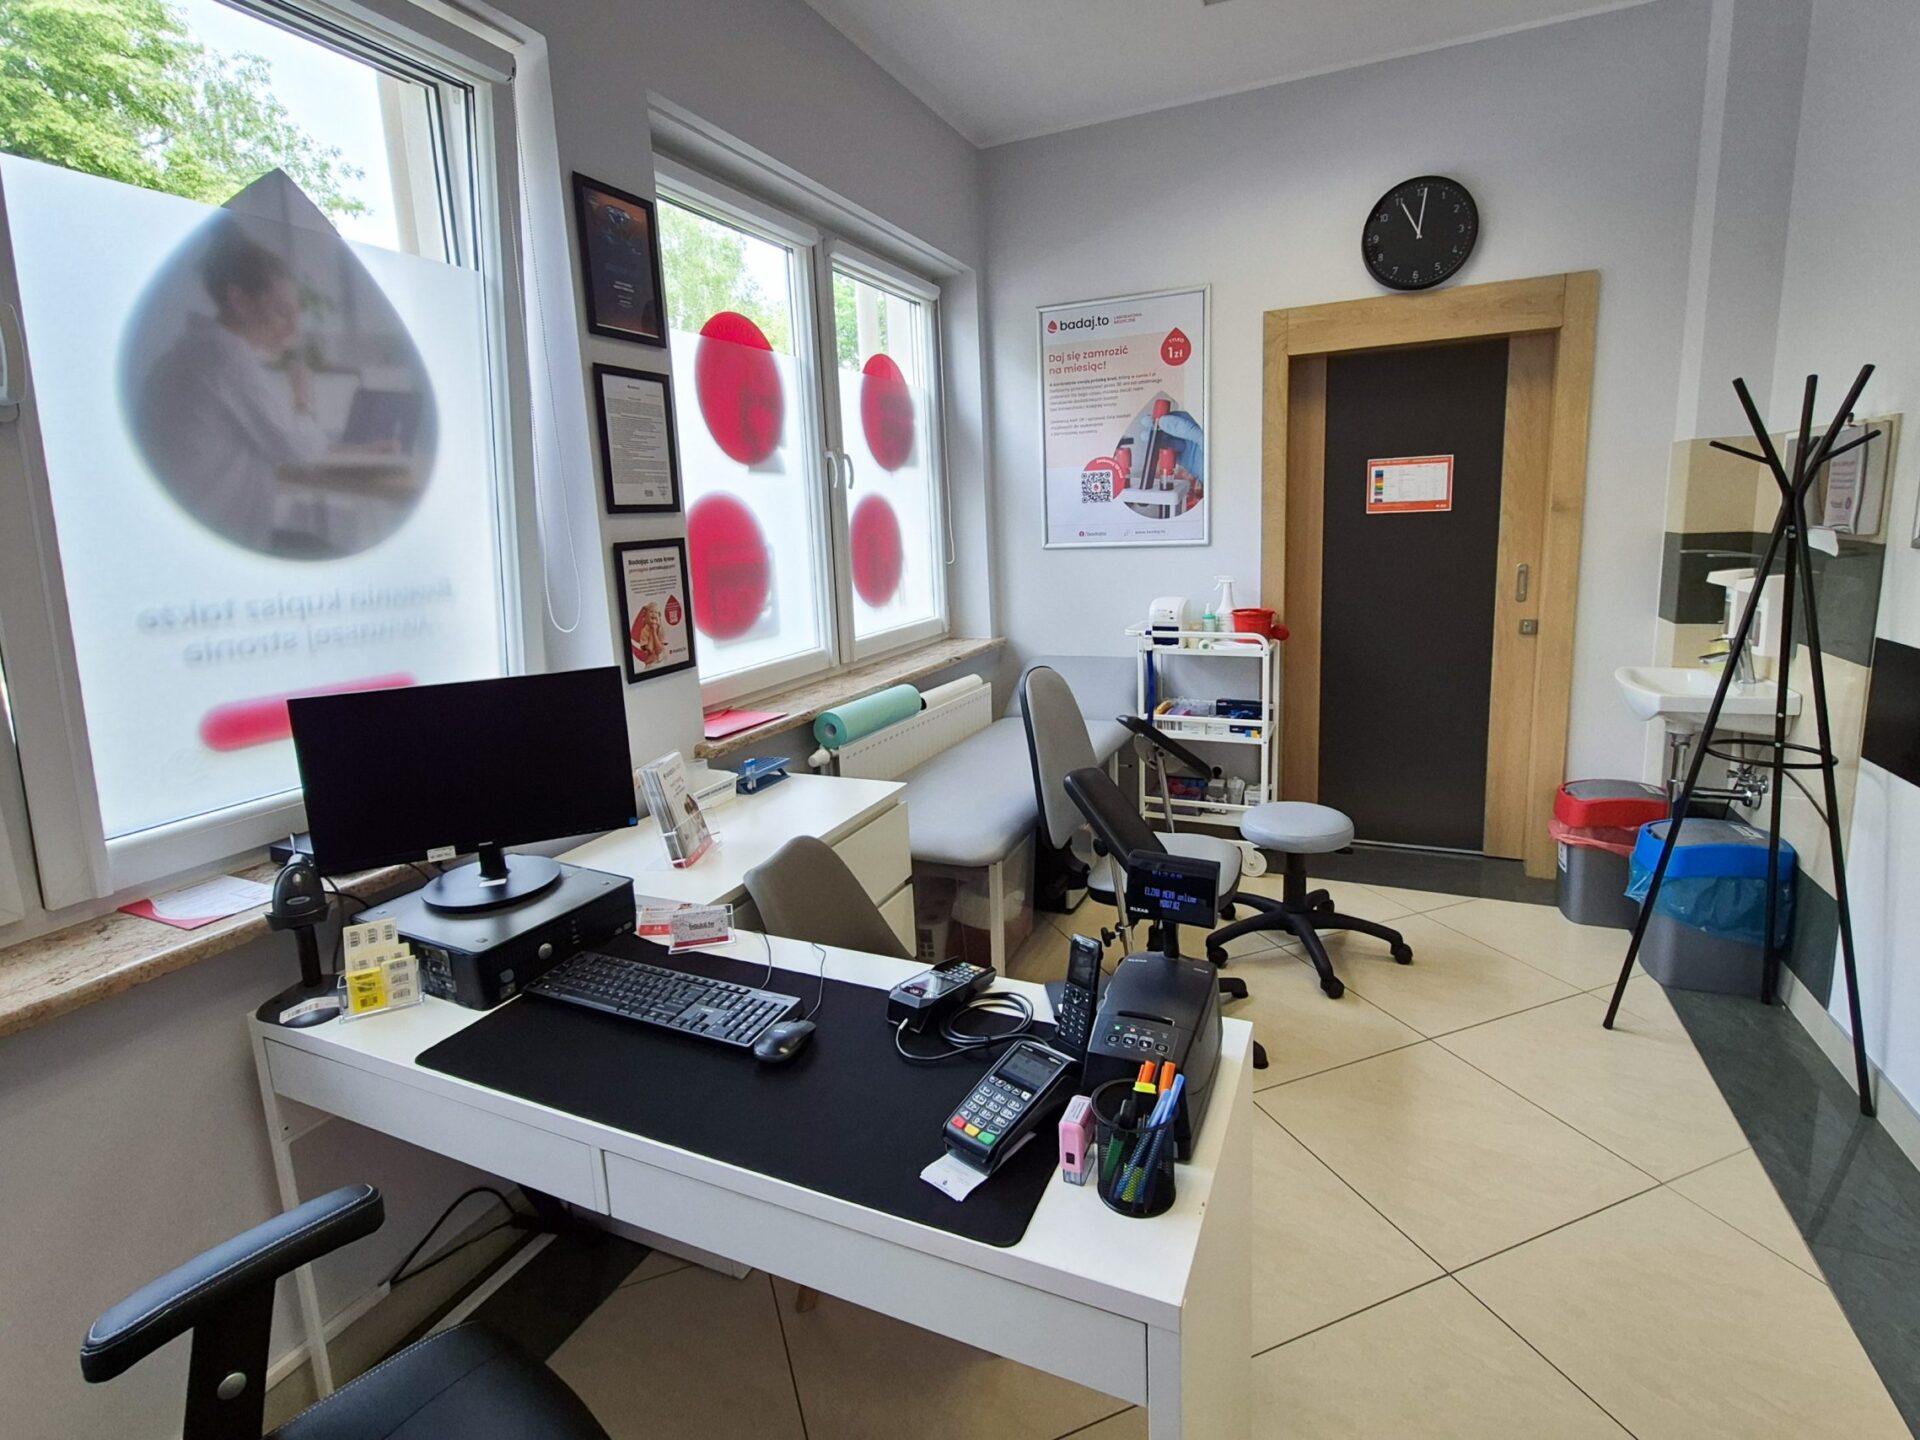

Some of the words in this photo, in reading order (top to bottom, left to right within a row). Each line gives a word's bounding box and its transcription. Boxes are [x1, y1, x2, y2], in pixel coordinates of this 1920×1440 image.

[1441, 191, 1446, 199] 1
[1453, 204, 1460, 213] 2
[1380, 213, 1389, 222] 10
[1458, 224, 1464, 233] 3
[1373, 234, 1379, 243] 9
[1452, 245, 1458, 253] 4
[1378, 253, 1383, 261] 8
[1392, 266, 1399, 275] 7
[1434, 262, 1440, 271] 5
[1412, 270, 1419, 279] 6
[1060, 315, 1109, 331] badaj.to
[1048, 352, 1065, 365] Daj
[1066, 351, 1081, 362] się
[1083, 345, 1129, 359] zamrozić
[1049, 367, 1062, 375] na
[1064, 360, 1106, 373] miesiąc!
